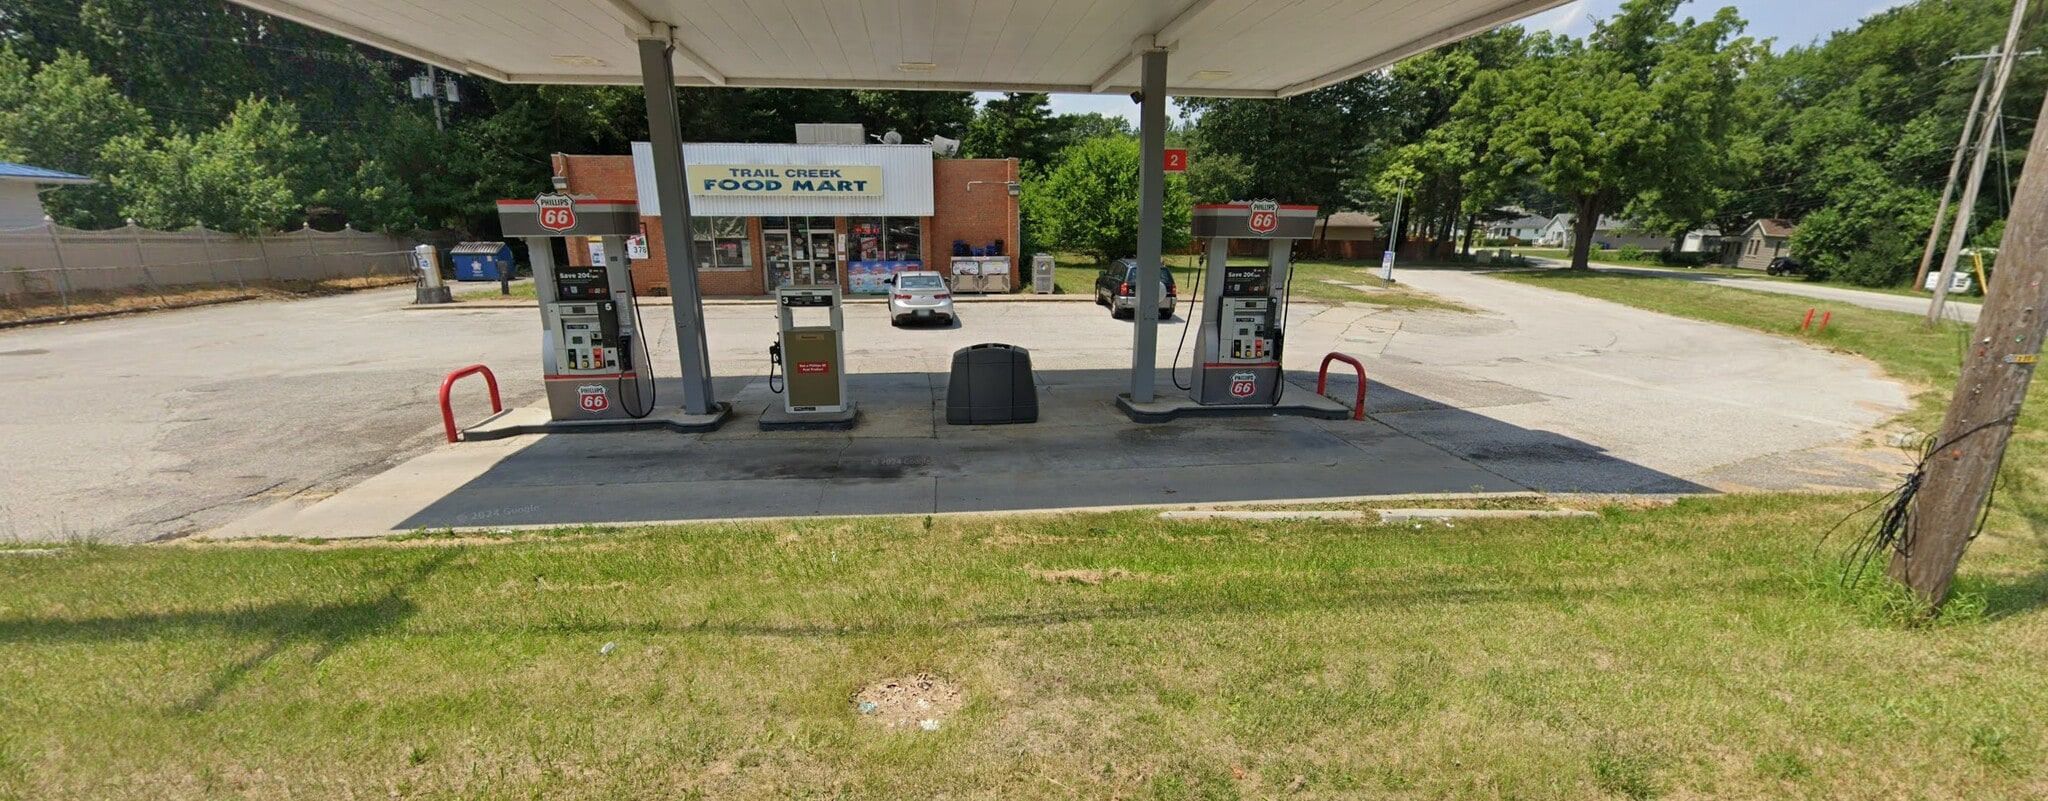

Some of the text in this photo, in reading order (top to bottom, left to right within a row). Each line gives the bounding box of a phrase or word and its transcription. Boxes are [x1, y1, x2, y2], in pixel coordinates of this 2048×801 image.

[1170, 154, 1178, 166] 2
[729, 168, 842, 178] TRAIL CREEK
[703, 179, 867, 192] FOOD MART
[540, 198, 569, 206] PHILLIPS
[1253, 203, 1276, 211] PHILLIPS
[545, 209, 569, 225] 66
[1253, 213, 1273, 227] 66
[782, 296, 789, 305] 3
[604, 302, 612, 311] 5
[1234, 382, 1252, 393] 66
[584, 396, 604, 407] 66
